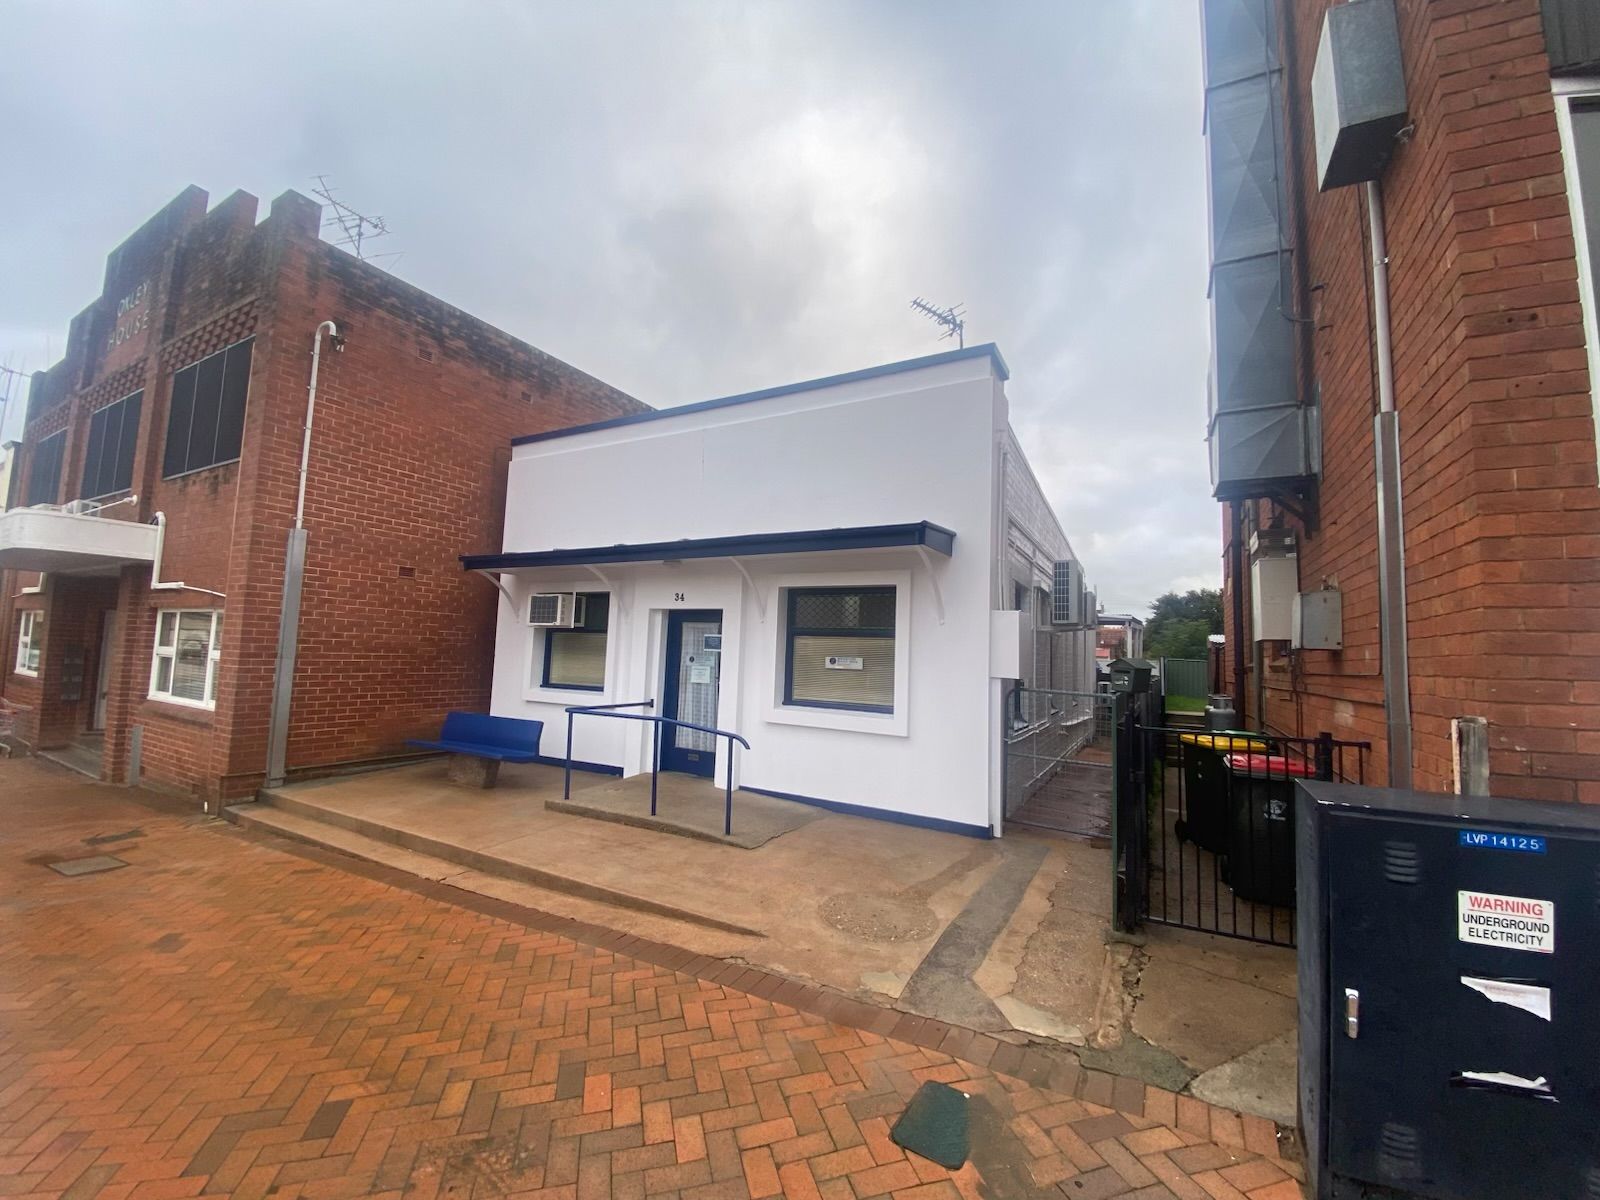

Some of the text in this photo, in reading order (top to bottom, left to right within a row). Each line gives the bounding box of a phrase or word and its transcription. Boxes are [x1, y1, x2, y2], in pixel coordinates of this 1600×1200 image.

[107, 309, 149, 352] HOUSE
[674, 592, 685, 602] 34
[1466, 833, 1540, 850] LVP 14125
[1469, 895, 1543, 916] WARNING
[1462, 913, 1550, 934] UNDERGROUND
[1468, 927, 1543, 946] ELECTRICITY
